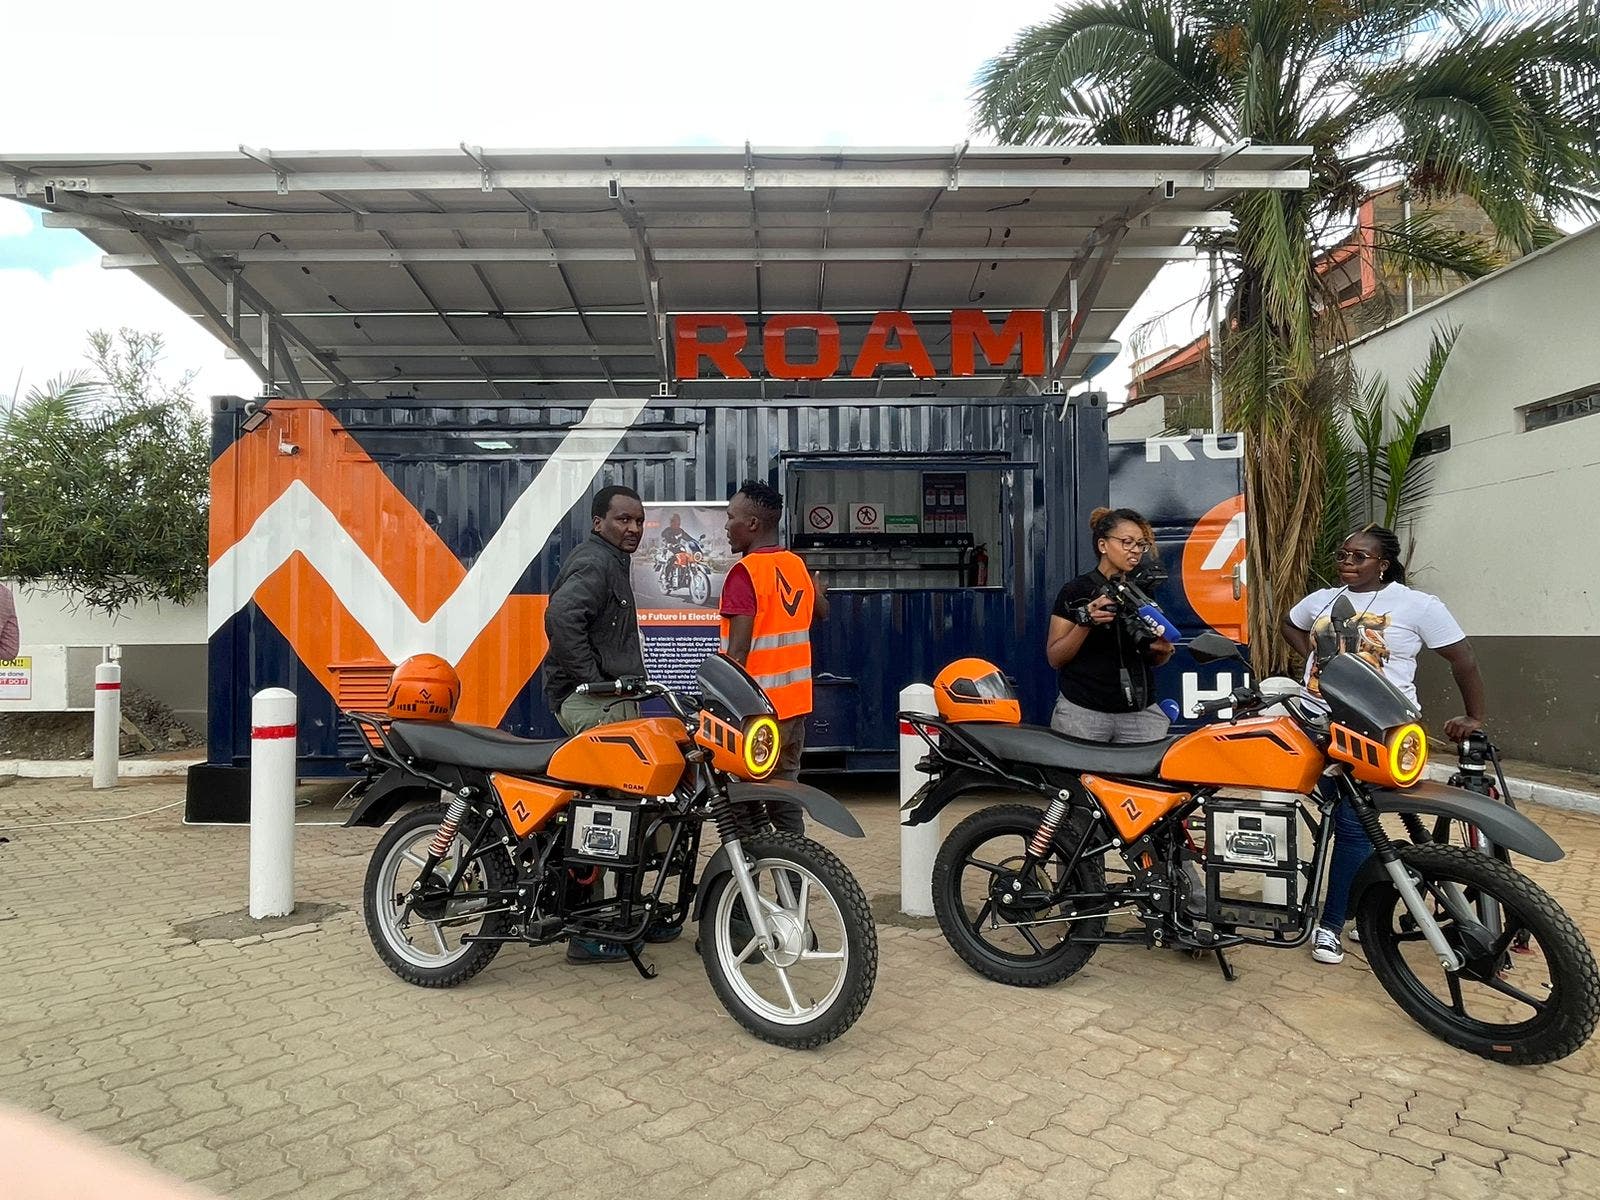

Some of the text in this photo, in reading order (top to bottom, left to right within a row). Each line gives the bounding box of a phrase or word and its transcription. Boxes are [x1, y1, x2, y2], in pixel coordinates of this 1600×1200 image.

[675, 310, 1046, 379] ROAM
[648, 612, 676, 620] Future
[679, 612, 687, 620] is
[688, 612, 721, 620] Electric
[623, 783, 644, 791] ROAM
